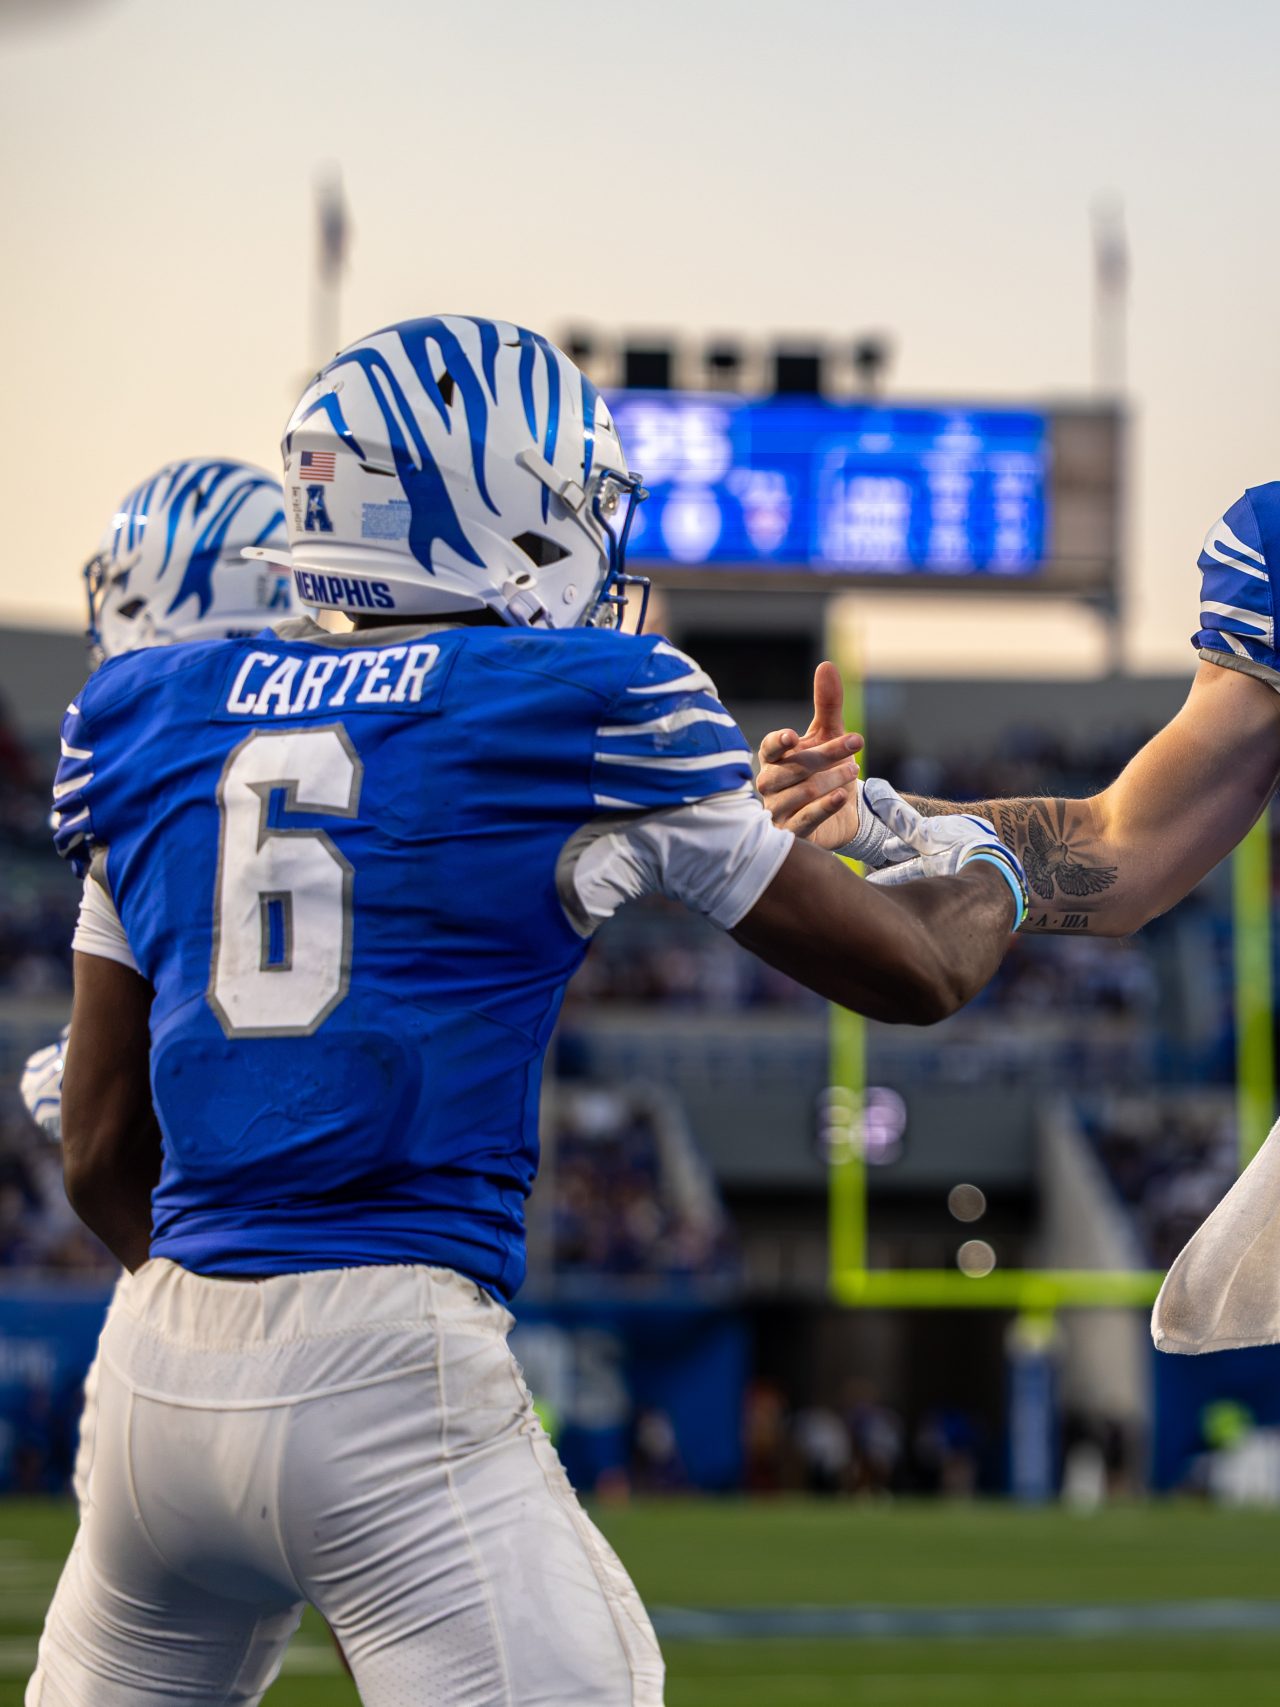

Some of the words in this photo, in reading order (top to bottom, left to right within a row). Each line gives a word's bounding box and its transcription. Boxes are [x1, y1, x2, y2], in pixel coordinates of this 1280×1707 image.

[304, 484, 334, 532] A
[226, 644, 440, 716] CARTER
[206, 721, 365, 1040] 6
